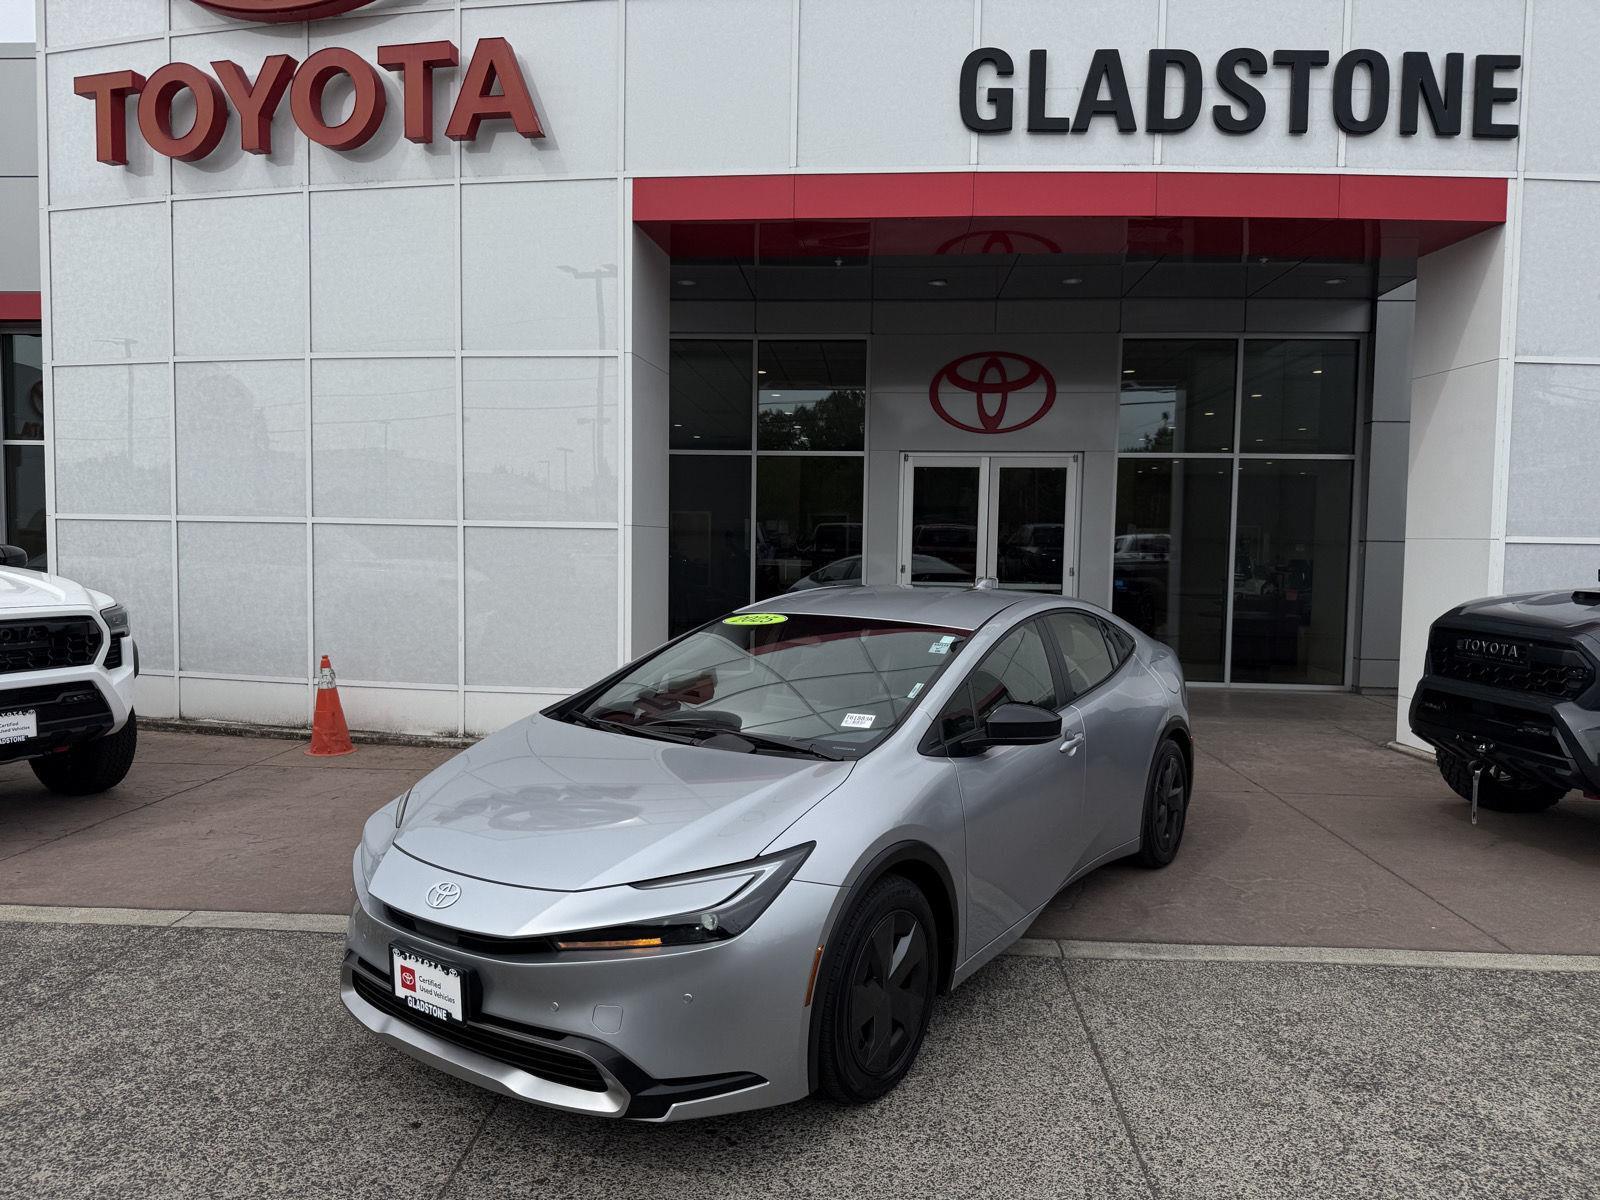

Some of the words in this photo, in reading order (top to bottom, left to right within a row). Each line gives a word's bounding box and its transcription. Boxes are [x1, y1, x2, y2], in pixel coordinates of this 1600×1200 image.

[74, 37, 545, 166] TOYOTA
[959, 47, 1522, 139] GLADSTONE
[1464, 638, 1518, 658] TOYOTA
[418, 975, 442, 989] Certified
[420, 984, 433, 996] Used
[433, 989, 456, 1004] Vehicles
[407, 996, 448, 1021] GLADSTONE
